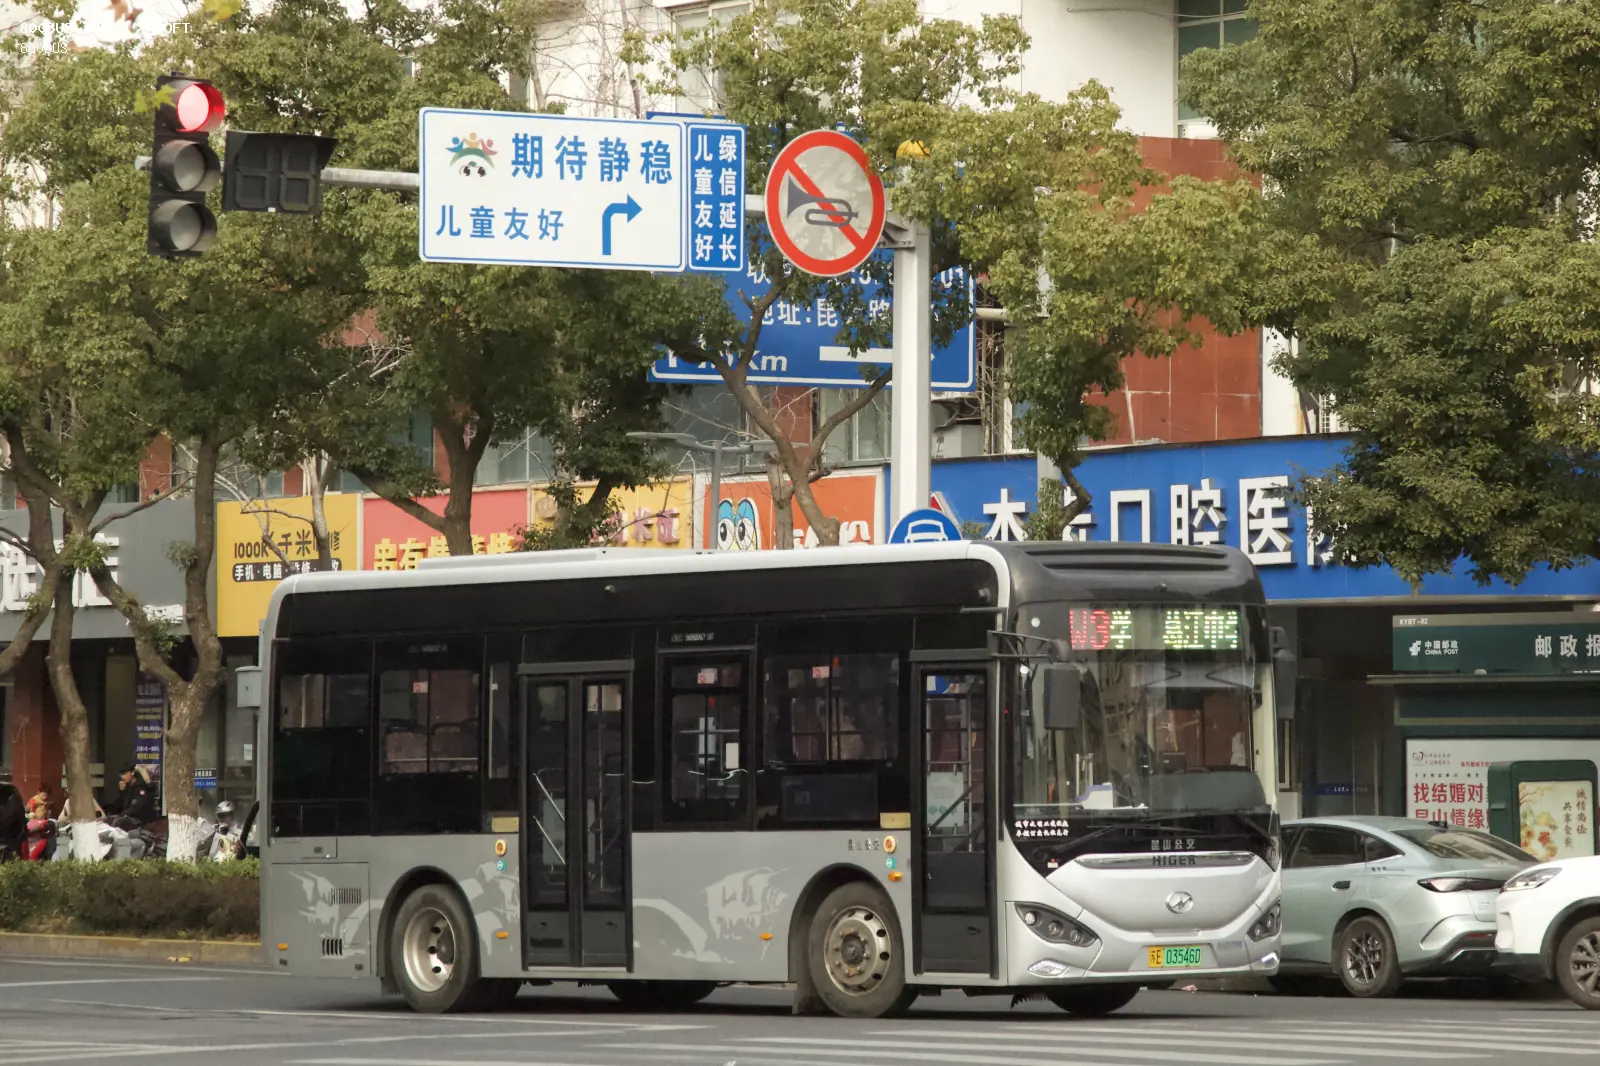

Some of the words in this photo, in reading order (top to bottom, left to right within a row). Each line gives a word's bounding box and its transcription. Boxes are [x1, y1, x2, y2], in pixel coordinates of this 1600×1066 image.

[511, 132, 673, 185] 期待静稳
[695, 134, 714, 262] 儿童友好
[718, 135, 738, 262] 绿信延长
[436, 205, 564, 241] 儿童友好
[1424, 640, 1459, 650] 中国邮政
[1413, 782, 1484, 803] 找结婚对
[1415, 808, 1490, 829] 昆山情缘
[1151, 838, 1196, 851] 昆山公交
[1151, 854, 1196, 867] HIGER
